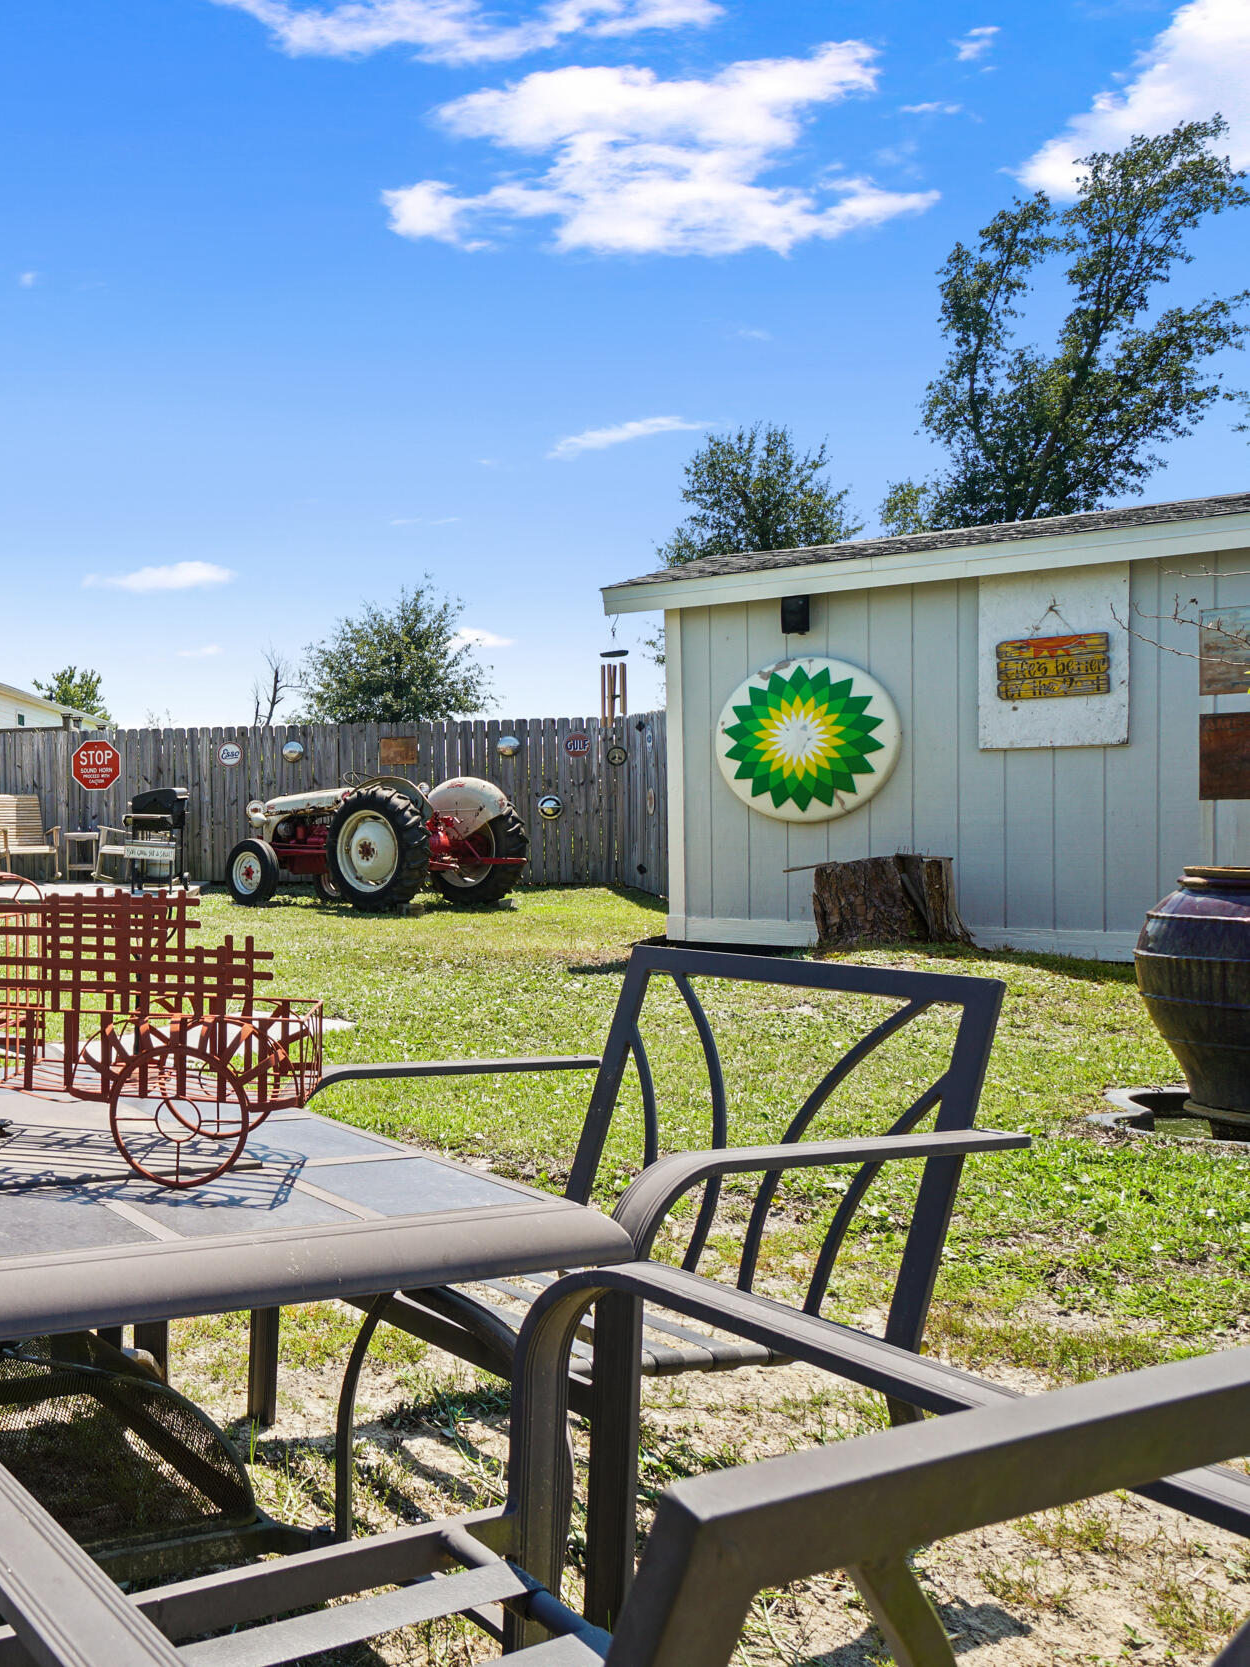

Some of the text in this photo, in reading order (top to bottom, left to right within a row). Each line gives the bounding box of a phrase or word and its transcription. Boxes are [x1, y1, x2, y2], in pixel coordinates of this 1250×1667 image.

[565, 739, 590, 752] GULF
[79, 750, 113, 766] STOP
[221, 748, 240, 760] Esso
